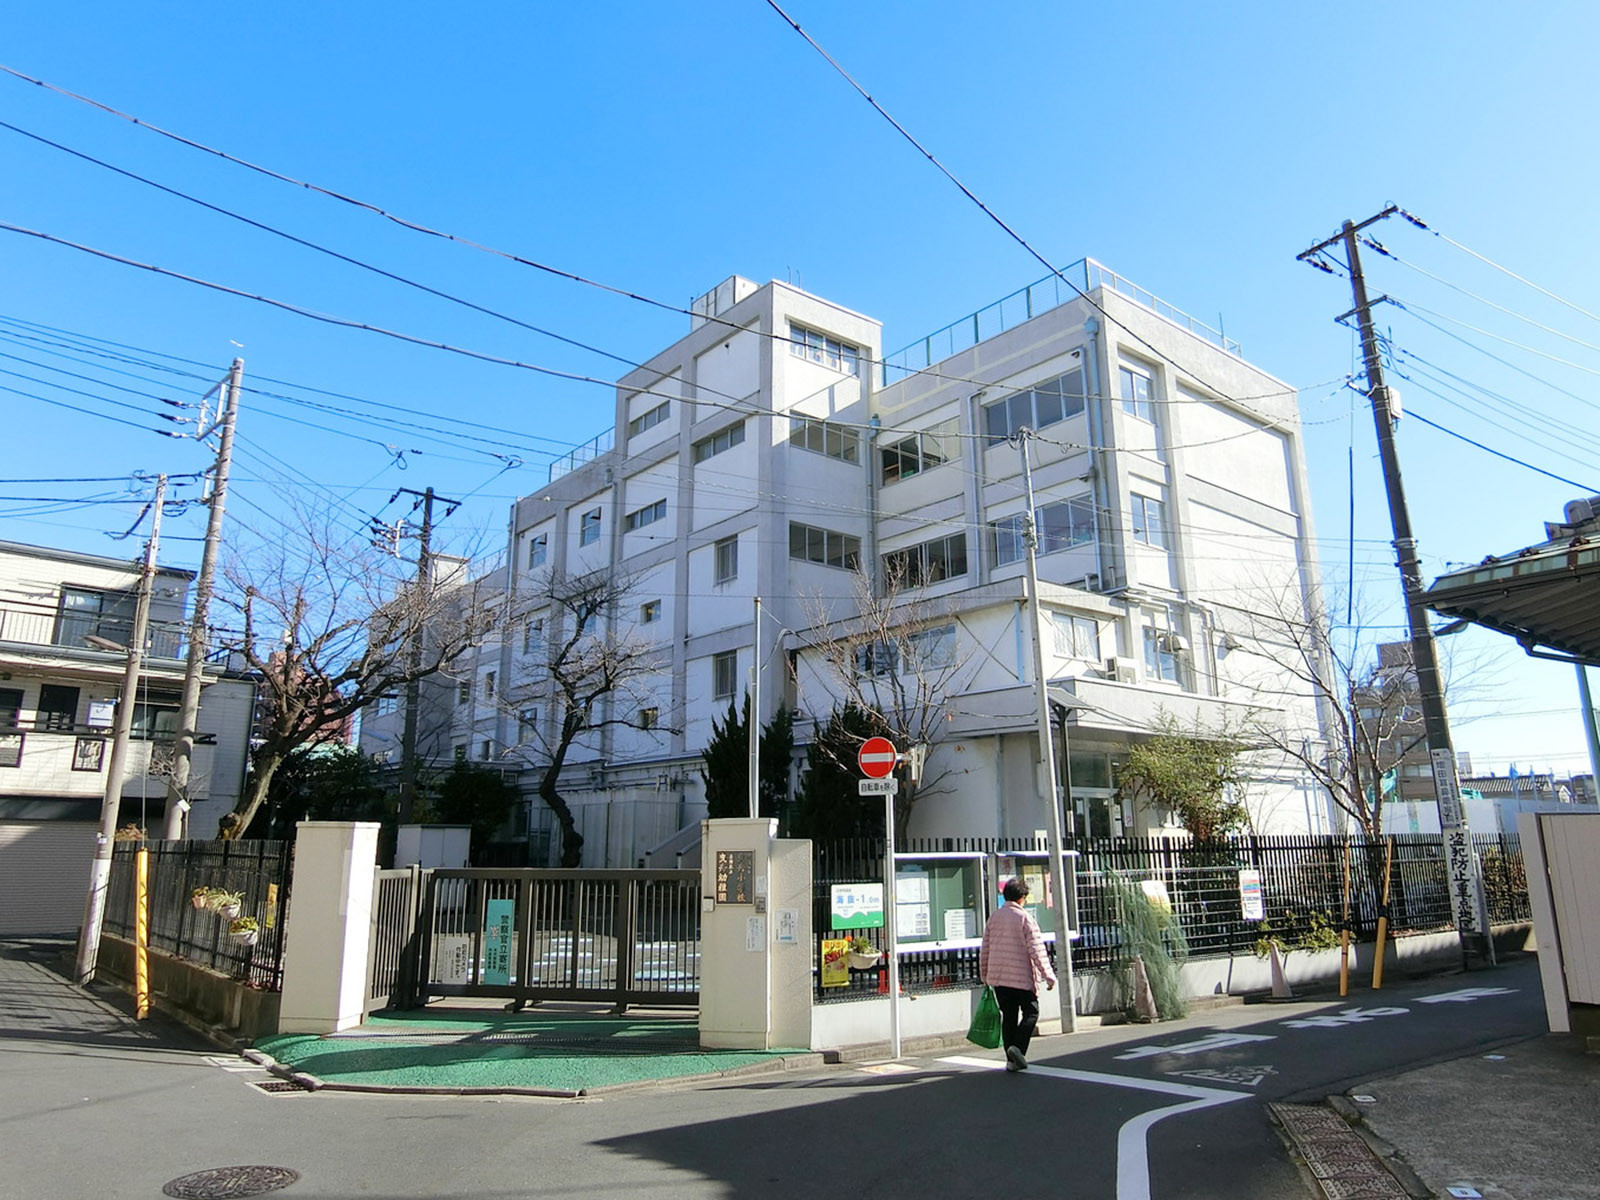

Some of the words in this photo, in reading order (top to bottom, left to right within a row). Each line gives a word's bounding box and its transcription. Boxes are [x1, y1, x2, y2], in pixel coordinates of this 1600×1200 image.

[861, 782, 896, 792] 自転車を除く
[1449, 831, 1476, 932] 盗犯防止重点地区
[498, 915, 509, 974] 警察官立寄所
